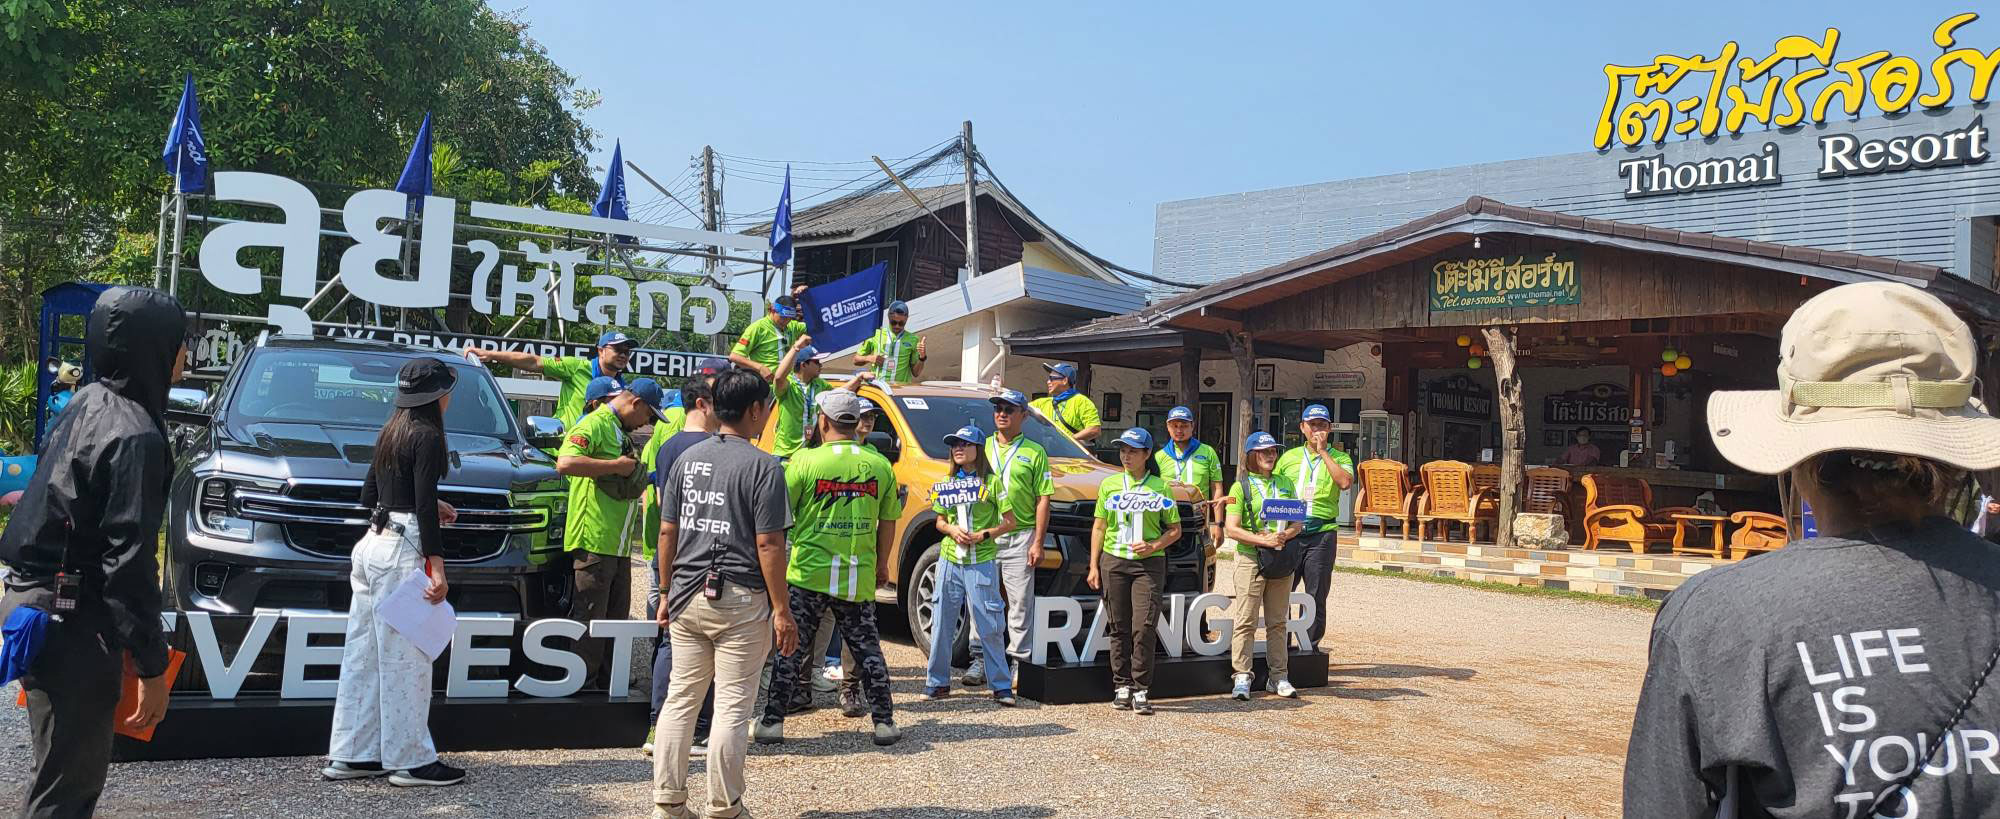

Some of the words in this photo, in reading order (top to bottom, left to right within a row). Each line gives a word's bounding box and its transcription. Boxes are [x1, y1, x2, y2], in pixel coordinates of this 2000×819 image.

[1620, 145, 1779, 196] Thomai
[1819, 122, 1987, 176] Resort
[200, 171, 456, 340] ลุย
[1433, 252, 1575, 295] โต๊ะไม้รีสอร์ท
[683, 475, 694, 488] IS
[684, 461, 713, 476] LIFE
[681, 502, 696, 517] TO
[682, 488, 725, 506] YOURS
[1119, 492, 1161, 510] Ford
[680, 516, 731, 535] MASTER
[1032, 591, 1317, 665] RNGR
[161, 611, 659, 700] VEEST
[1796, 627, 1930, 686] LIFE
[1813, 685, 1877, 737] IS
